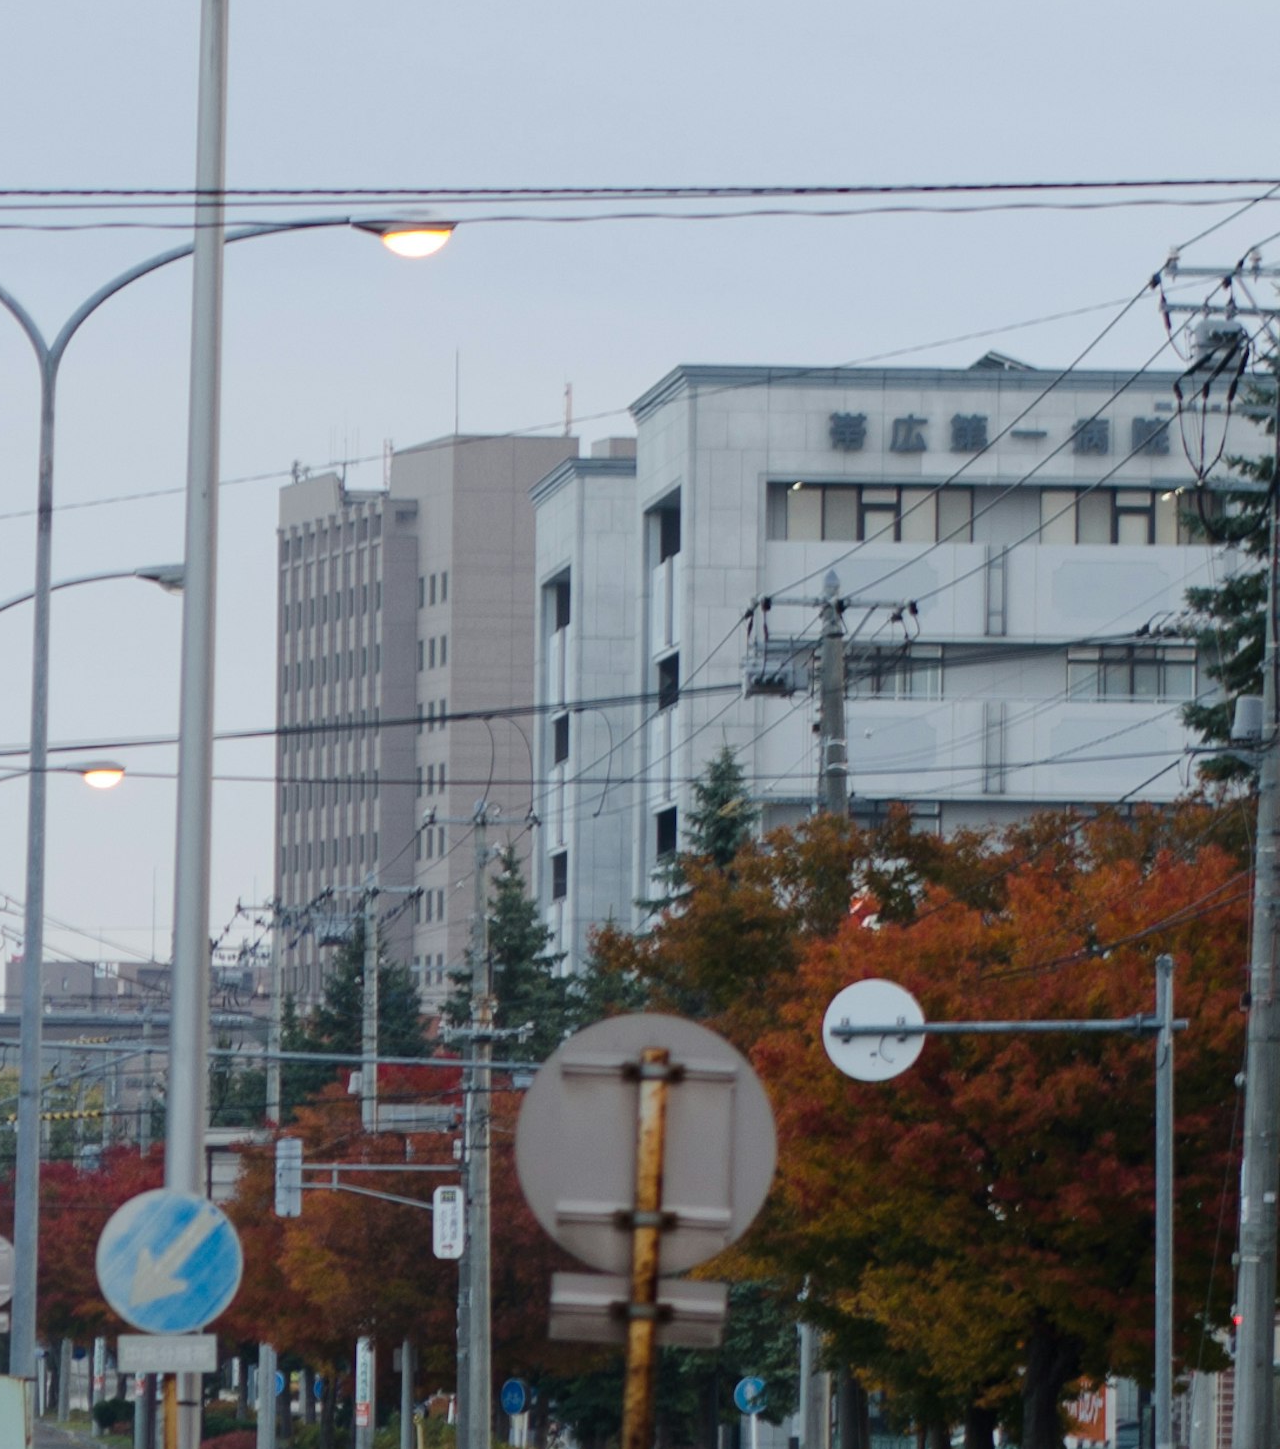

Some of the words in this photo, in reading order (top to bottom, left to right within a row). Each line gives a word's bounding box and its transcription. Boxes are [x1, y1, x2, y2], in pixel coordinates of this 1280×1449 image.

[829, 412, 1171, 454] 帯広第一病院
